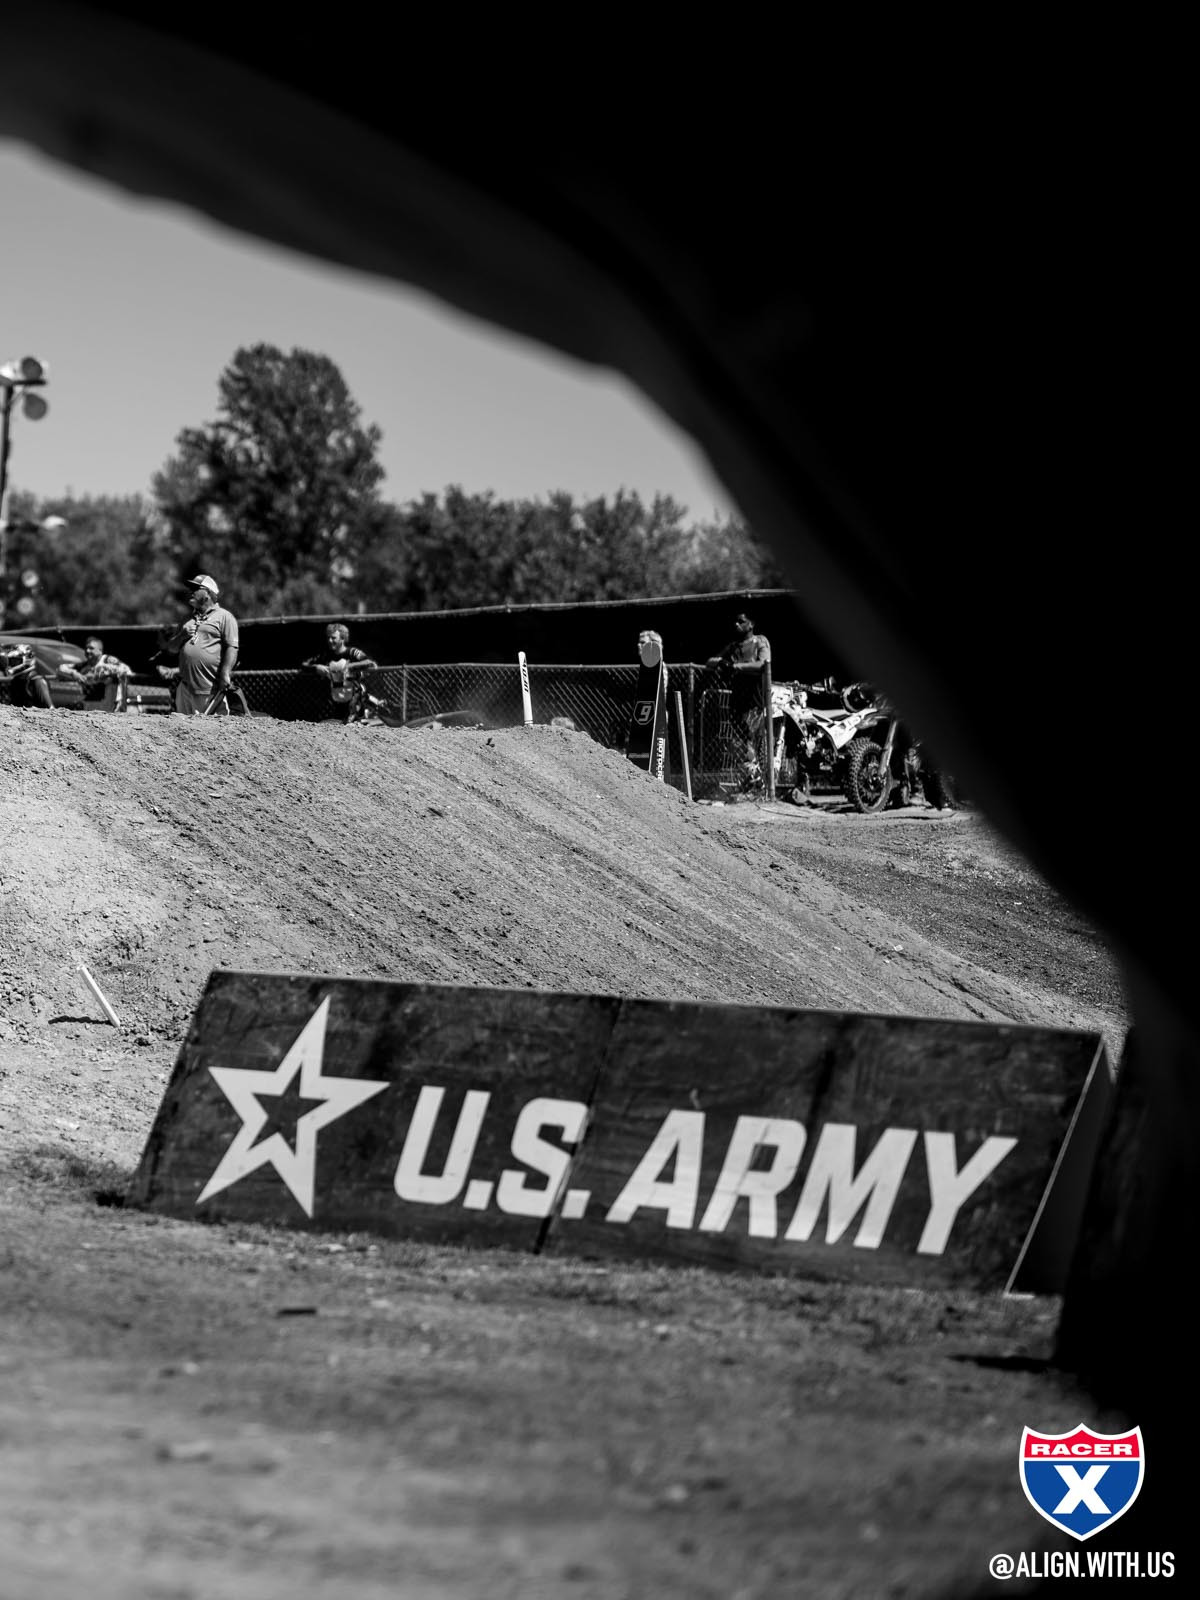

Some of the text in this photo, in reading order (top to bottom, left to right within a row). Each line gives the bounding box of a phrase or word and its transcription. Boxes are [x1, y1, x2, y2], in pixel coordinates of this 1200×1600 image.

[638, 705, 651, 722] 9
[394, 1085, 1017, 1255] U.S. ARMY
